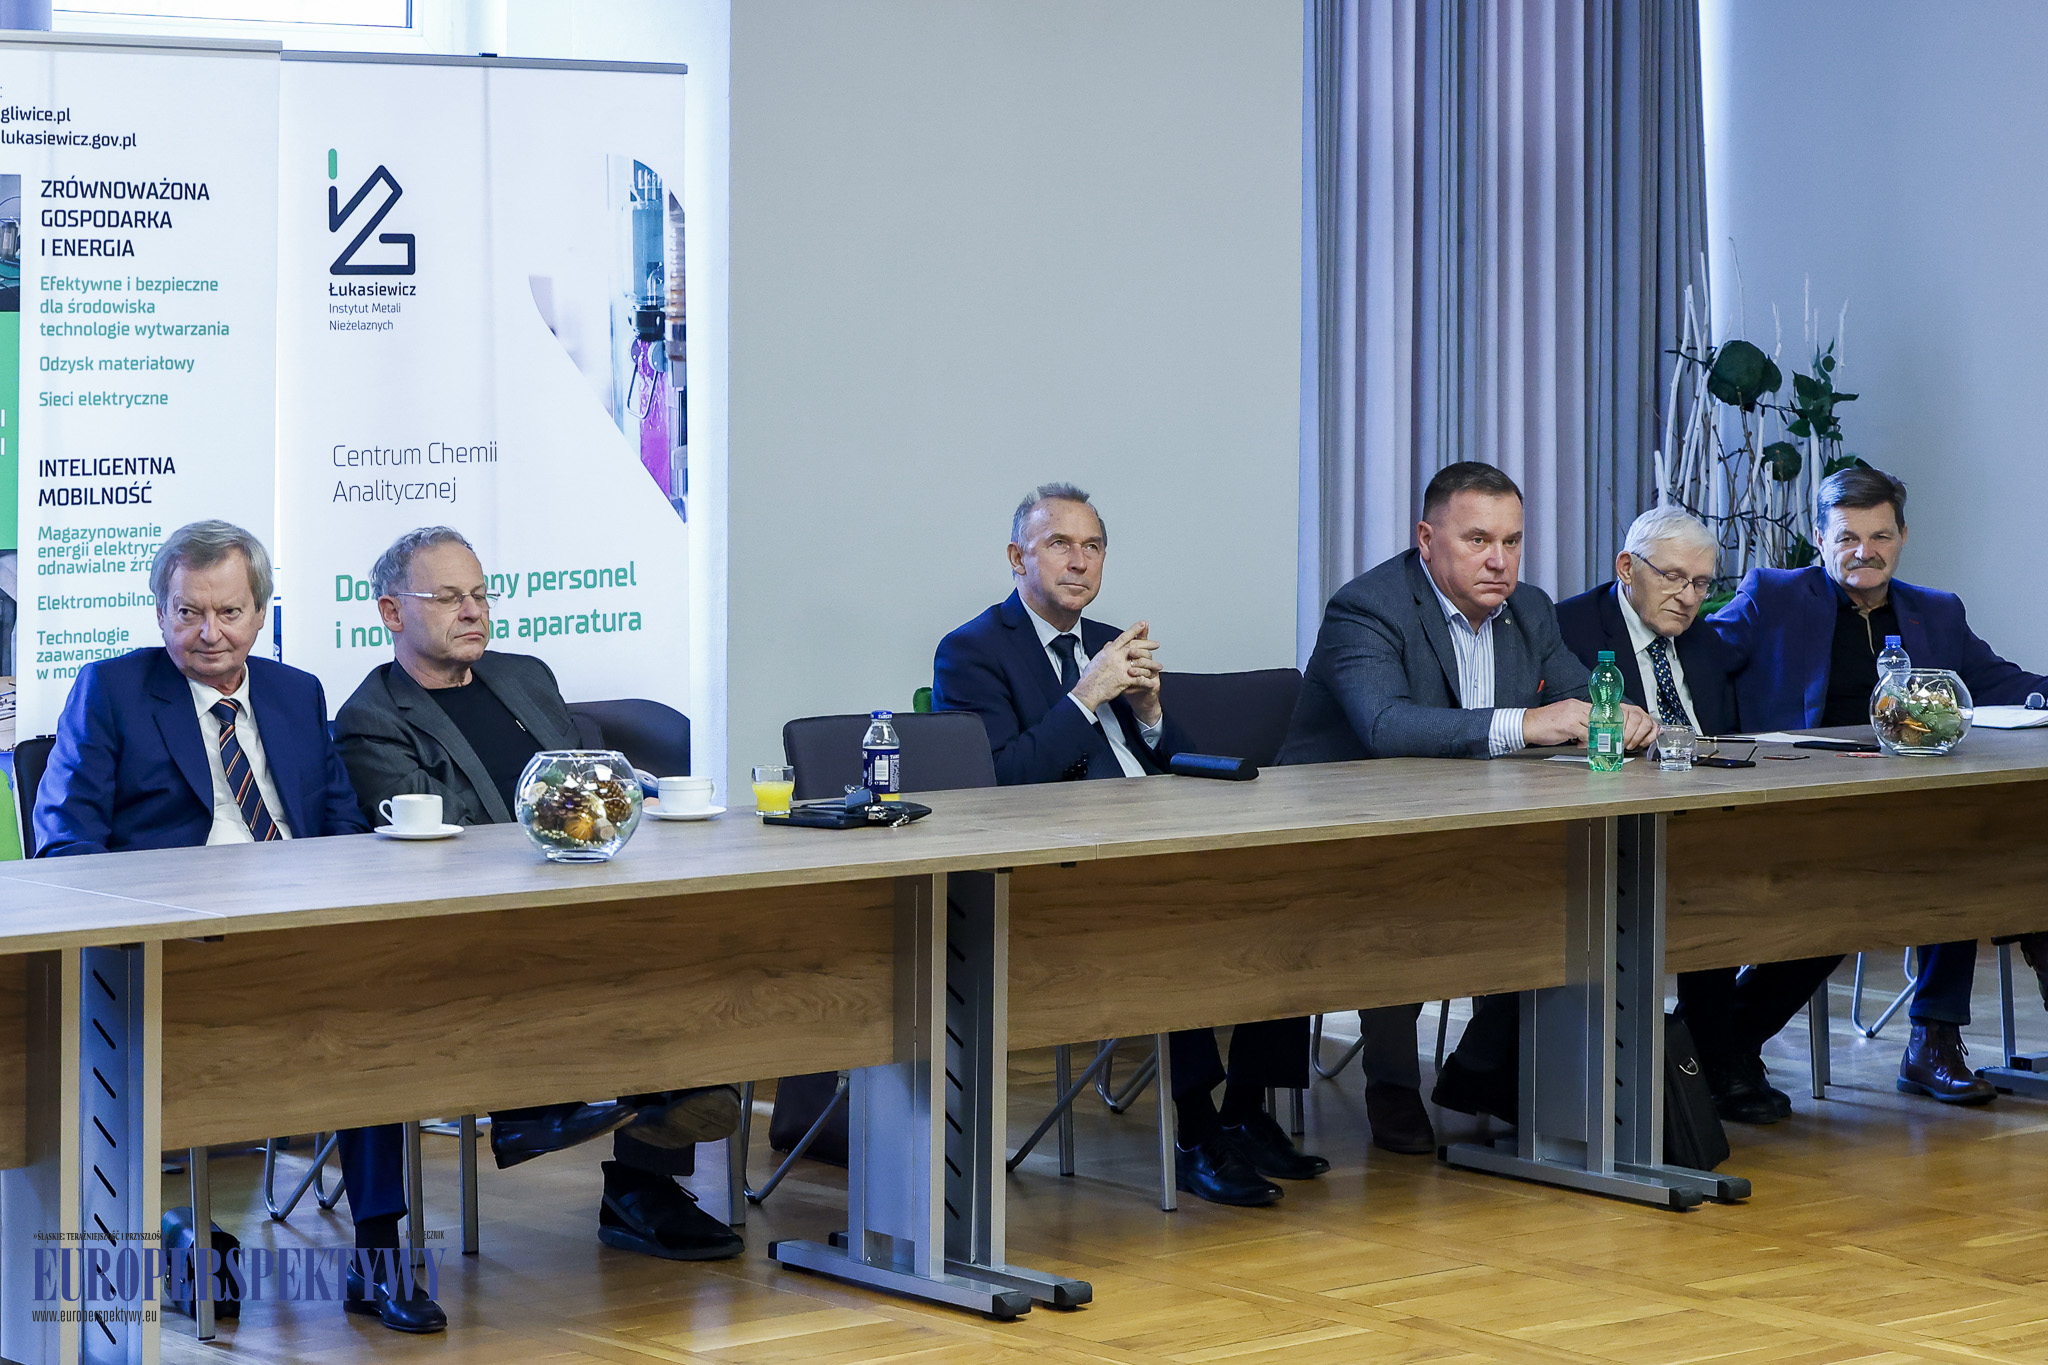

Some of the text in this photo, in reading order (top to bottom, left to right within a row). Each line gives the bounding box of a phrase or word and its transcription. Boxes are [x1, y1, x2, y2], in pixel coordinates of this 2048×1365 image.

[1, 105, 71, 123] gliwice.pl
[1, 130, 137, 150] lukasiewicz.gov.pl
[41, 175, 210, 201] ZRÓWNOWAŻONA
[41, 209, 173, 229] GOSPODARKA
[41, 239, 135, 257] I ENERGIA
[40, 276, 219, 294] Efektywne i bezpieczne
[328, 282, 417, 297] Łukasiewicz
[40, 298, 156, 314] dla środowiska
[329, 302, 401, 315] Instytut Metali
[40, 321, 230, 339] technologie wytwarzania
[329, 319, 394, 333] Nieżelaznych
[39, 356, 195, 374] Odzysk materiałowy
[39, 391, 169, 409] Sieci elektryczne
[333, 441, 498, 467] Centrum Chemii
[39, 456, 176, 478] INTELIGENTNA
[38, 481, 153, 507] MOBILNOŚĆ
[332, 476, 457, 505] Analitycznej
[38, 522, 162, 543] Magazynowanie
[38, 542, 89, 560] energii
[38, 559, 126, 575] odnawialne
[528, 560, 637, 598] personel
[38, 592, 155, 611] Elektromobilno
[37, 627, 129, 645] Technologie
[336, 620, 342, 649] i
[517, 608, 642, 642] aparatura
[37, 669, 48, 680] w
